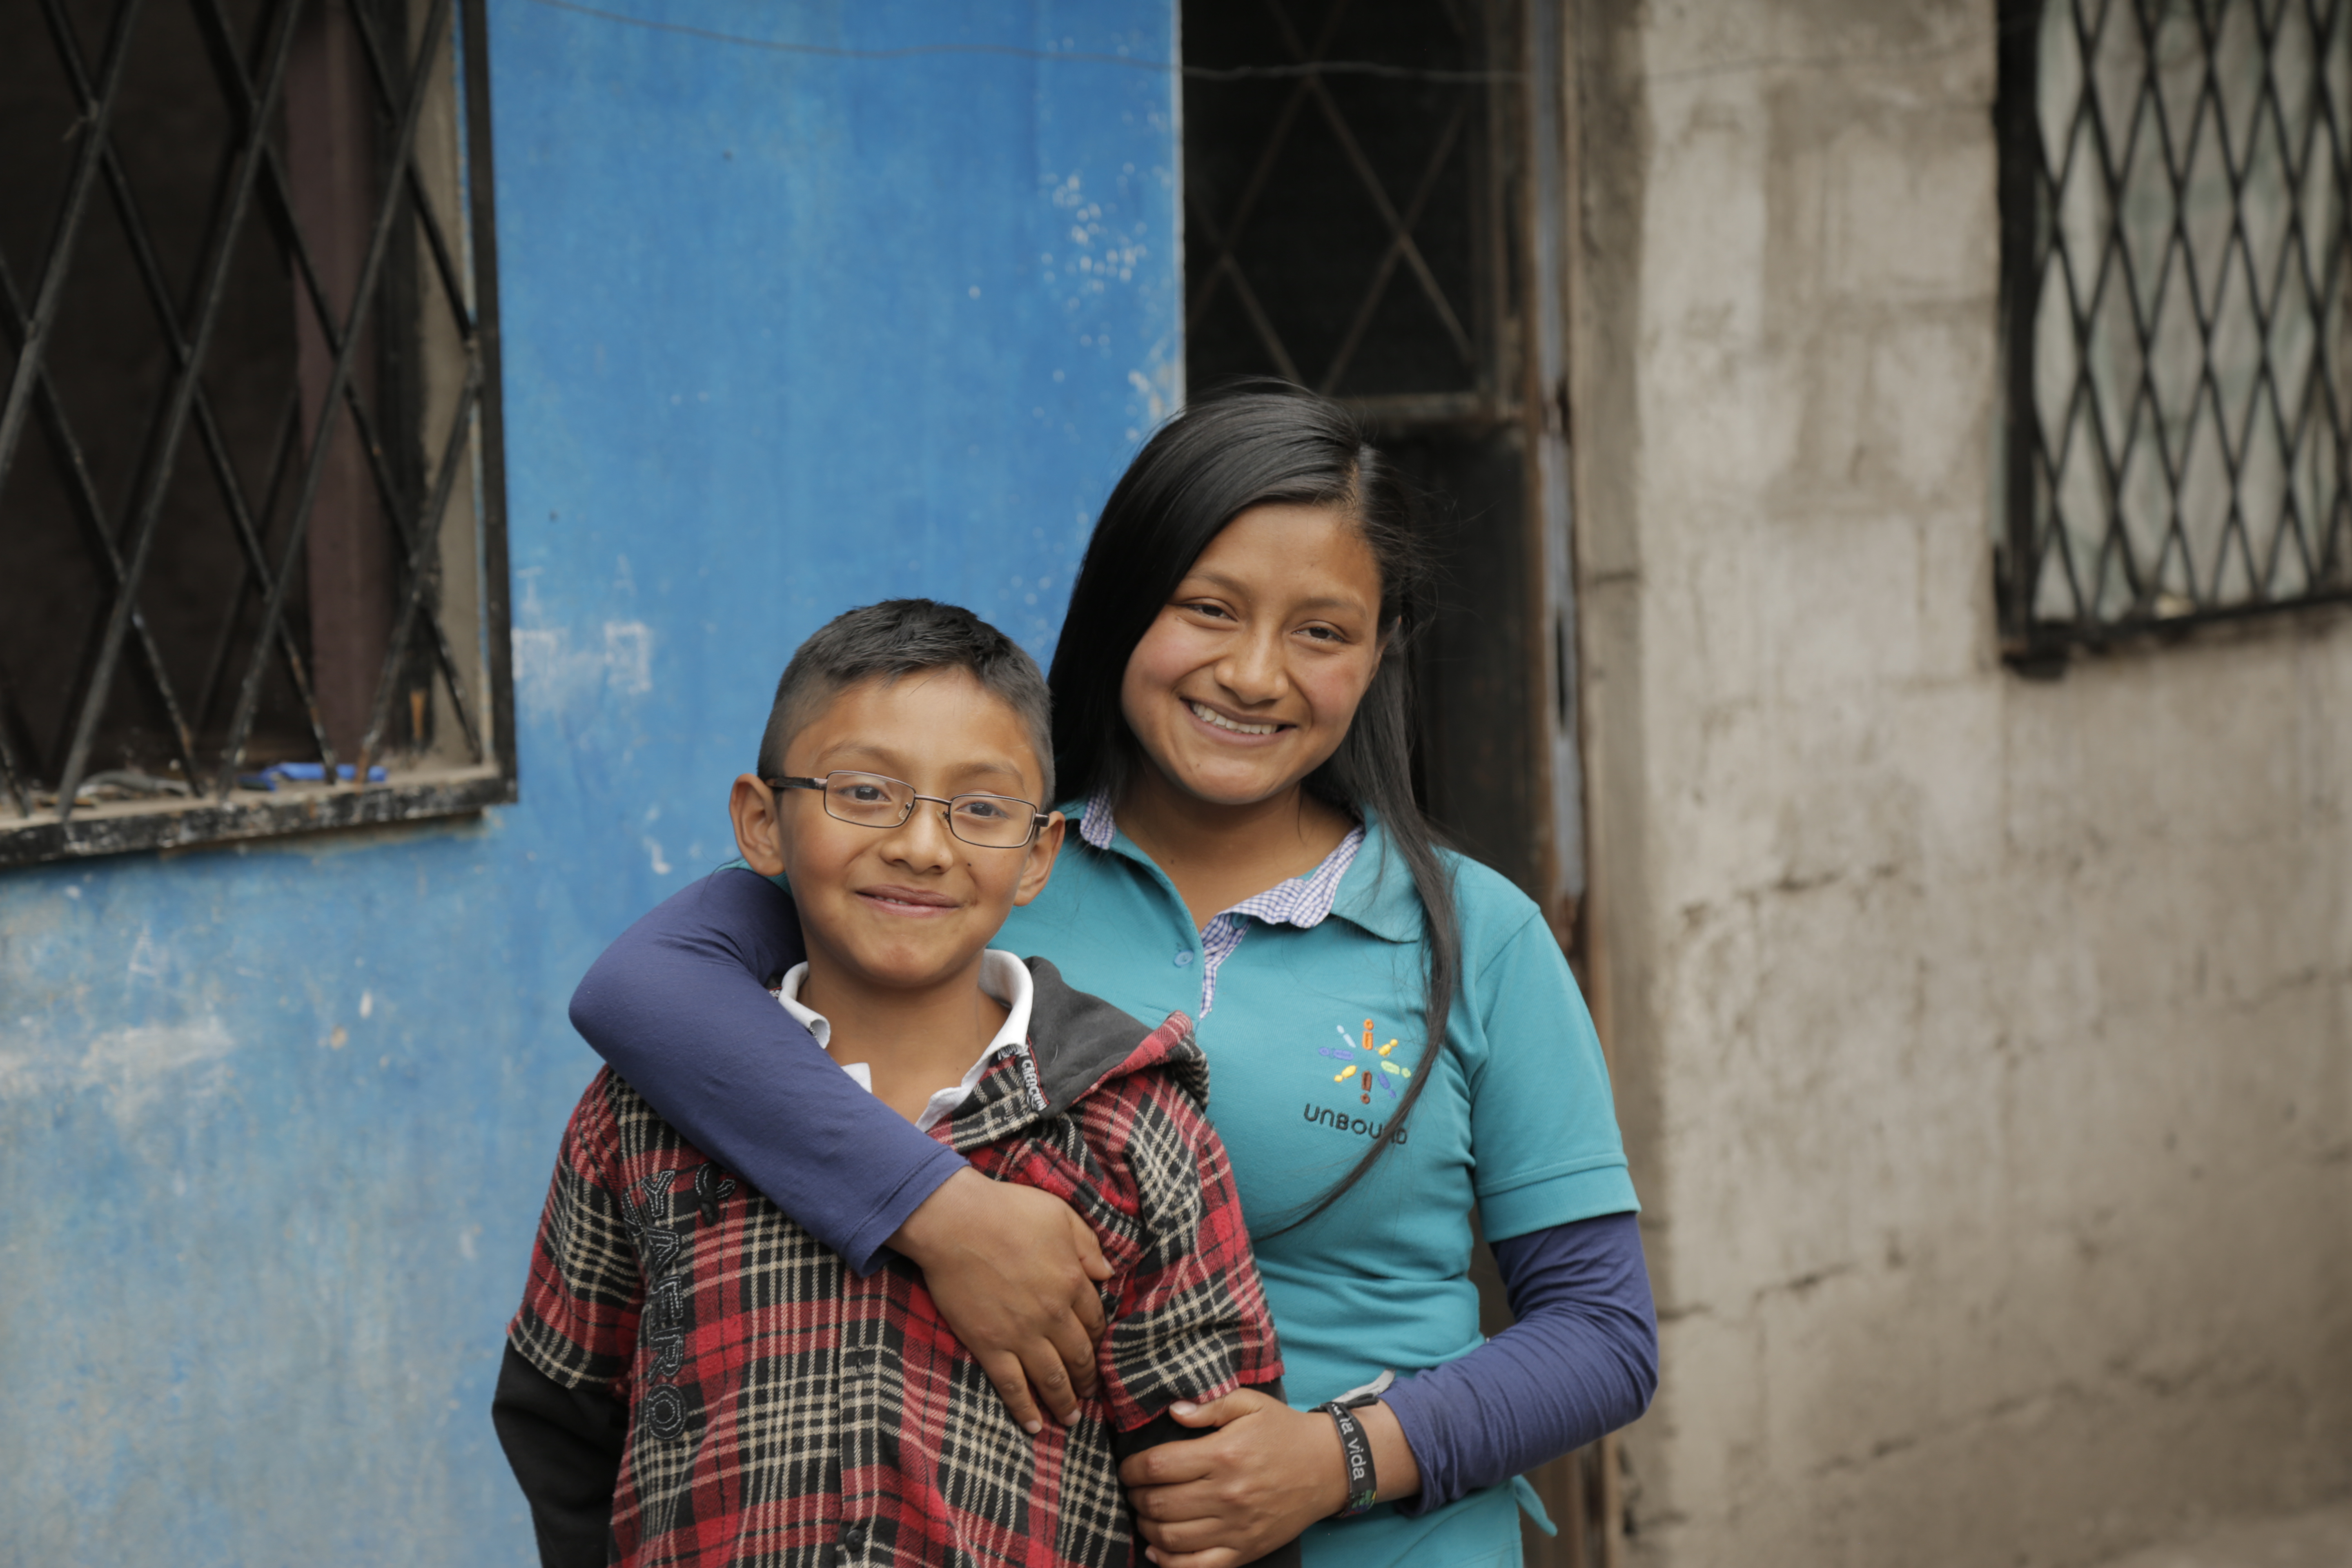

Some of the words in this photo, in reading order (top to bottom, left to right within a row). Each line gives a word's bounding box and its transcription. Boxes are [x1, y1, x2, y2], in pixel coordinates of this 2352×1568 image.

[1304, 1103, 1408, 1145] UNBOUD
[1339, 1418, 1354, 1435] la
[1348, 1437, 1367, 1481] vida
